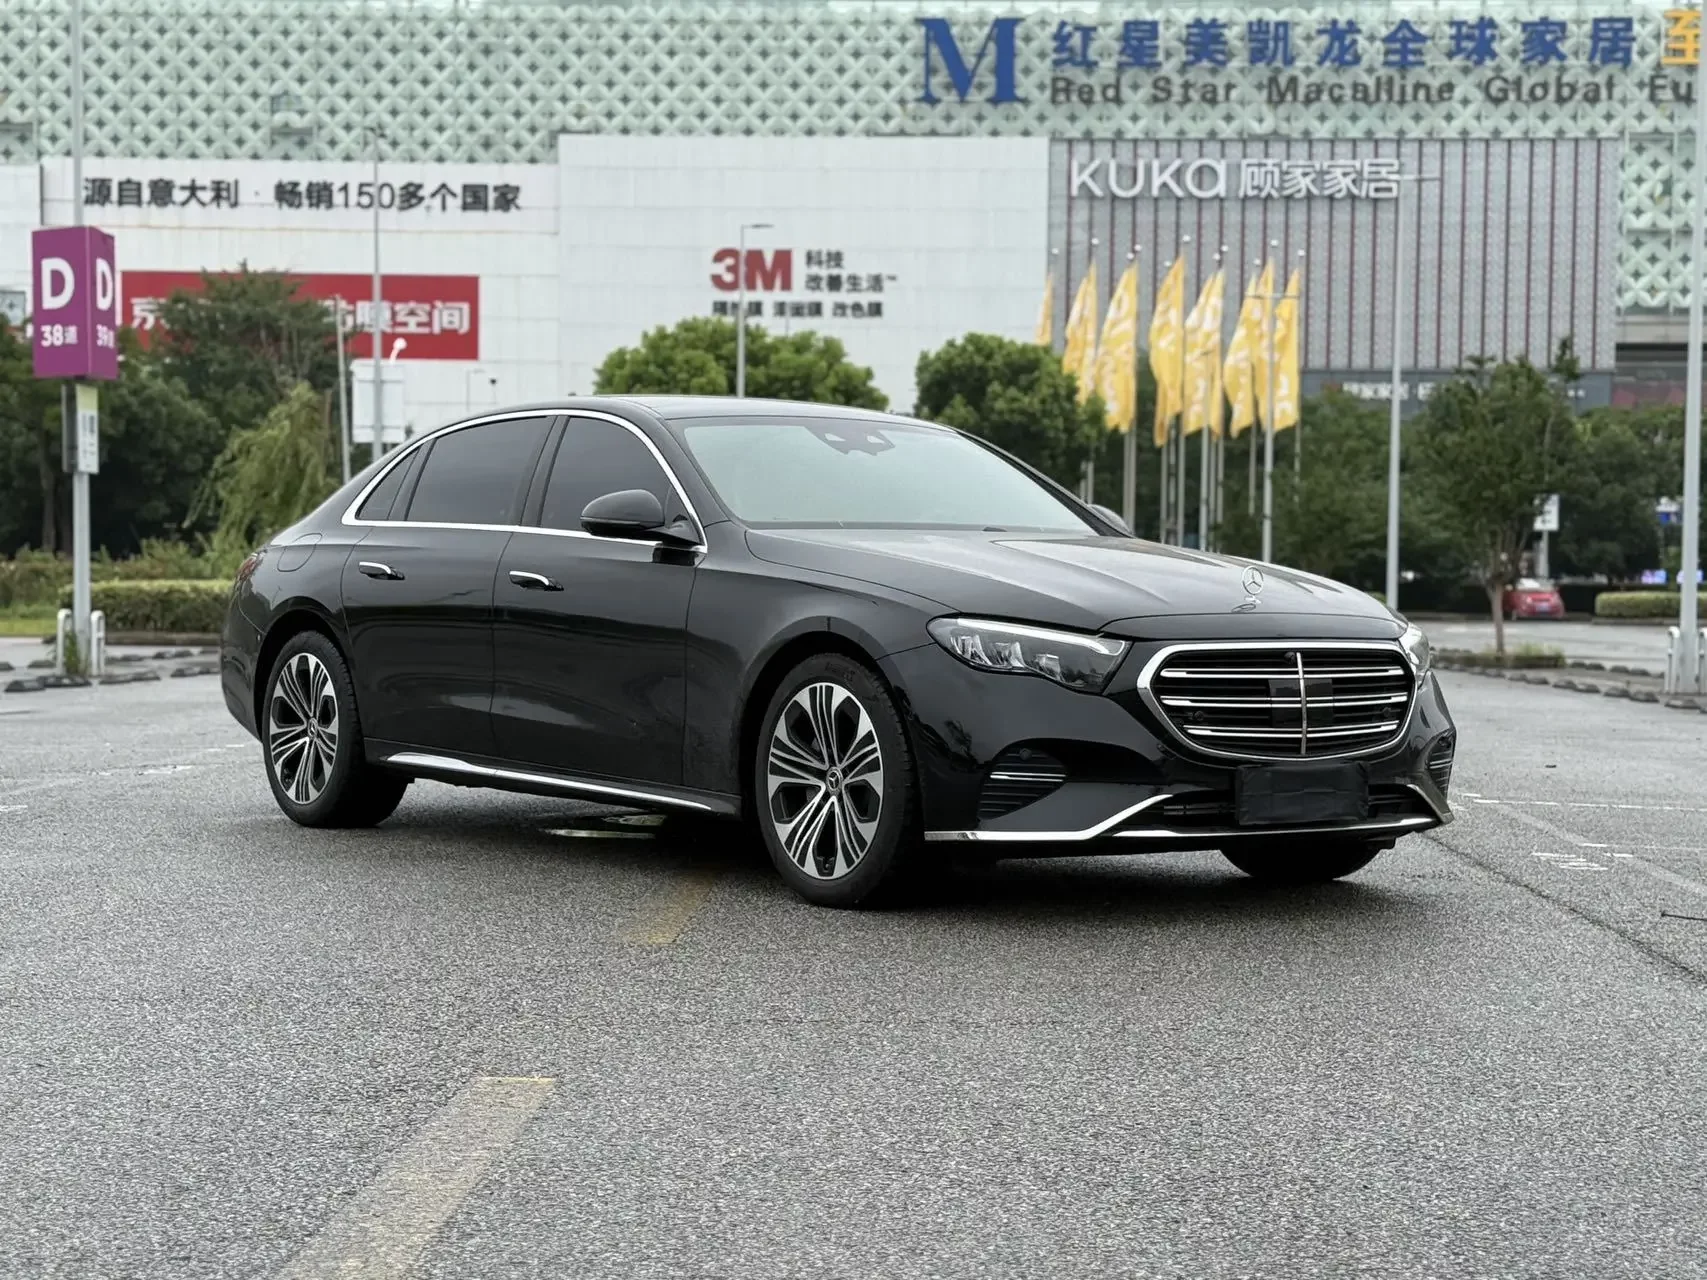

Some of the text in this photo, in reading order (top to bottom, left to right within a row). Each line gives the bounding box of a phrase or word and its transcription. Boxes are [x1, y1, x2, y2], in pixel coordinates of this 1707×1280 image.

[914, 17, 1027, 105] M
[1051, 17, 1637, 68] 红星美凯龙全球家居
[1662, 8, 1701, 66] 至
[1051, 76, 1121, 104] Red
[1152, 76, 1237, 104] Star
[1267, 75, 1455, 104] Macalline
[1485, 75, 1614, 104] Global
[84, 177, 522, 212] 源自意大利 畅销150多个国家
[1240, 158, 1400, 200] 顾家家居
[41, 257, 75, 310] D
[710, 247, 793, 292] 3M
[806, 250, 844, 269] 科技
[96, 257, 114, 311] D
